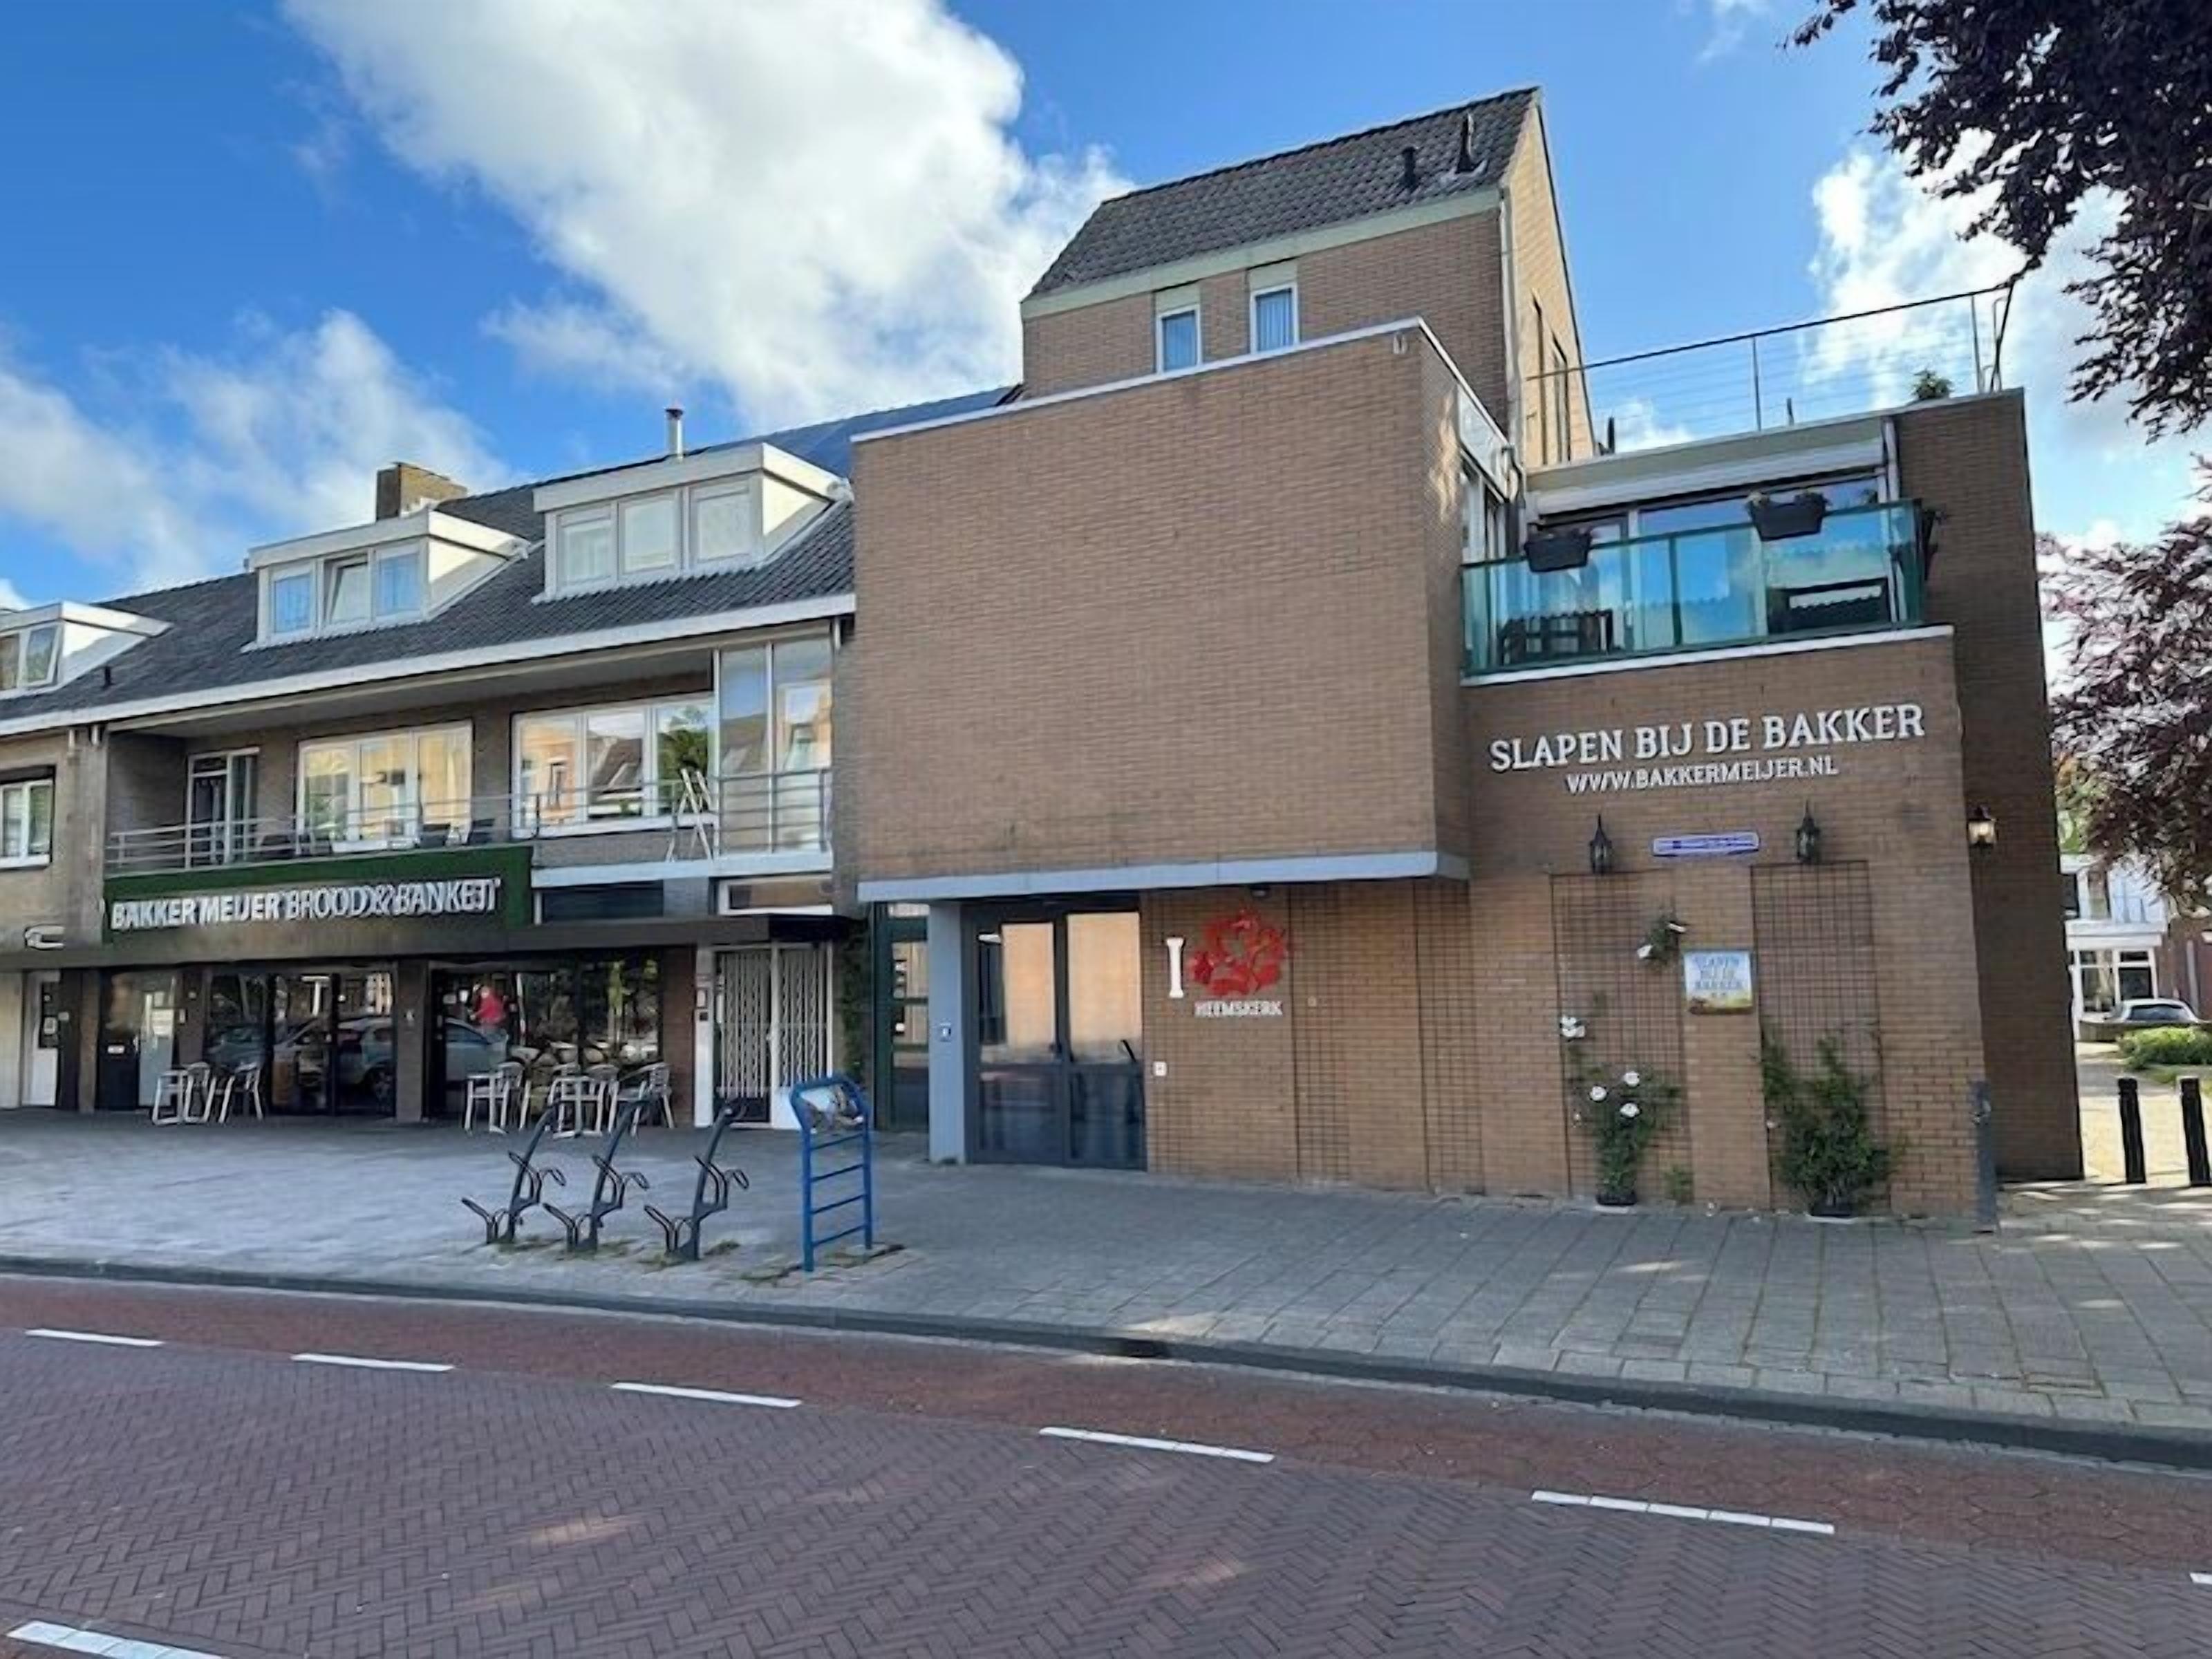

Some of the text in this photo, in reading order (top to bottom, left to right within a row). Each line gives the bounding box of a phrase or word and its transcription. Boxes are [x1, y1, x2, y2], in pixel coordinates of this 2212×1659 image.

[1490, 704, 1925, 772] SLAPEN BIJ DE BAKKER
[1566, 755, 1839, 794] WWW.BAKKERMEIJER.NL
[111, 897, 196, 930] BAKKER
[198, 892, 279, 926] MEIJER
[1165, 937, 1184, 998] I
